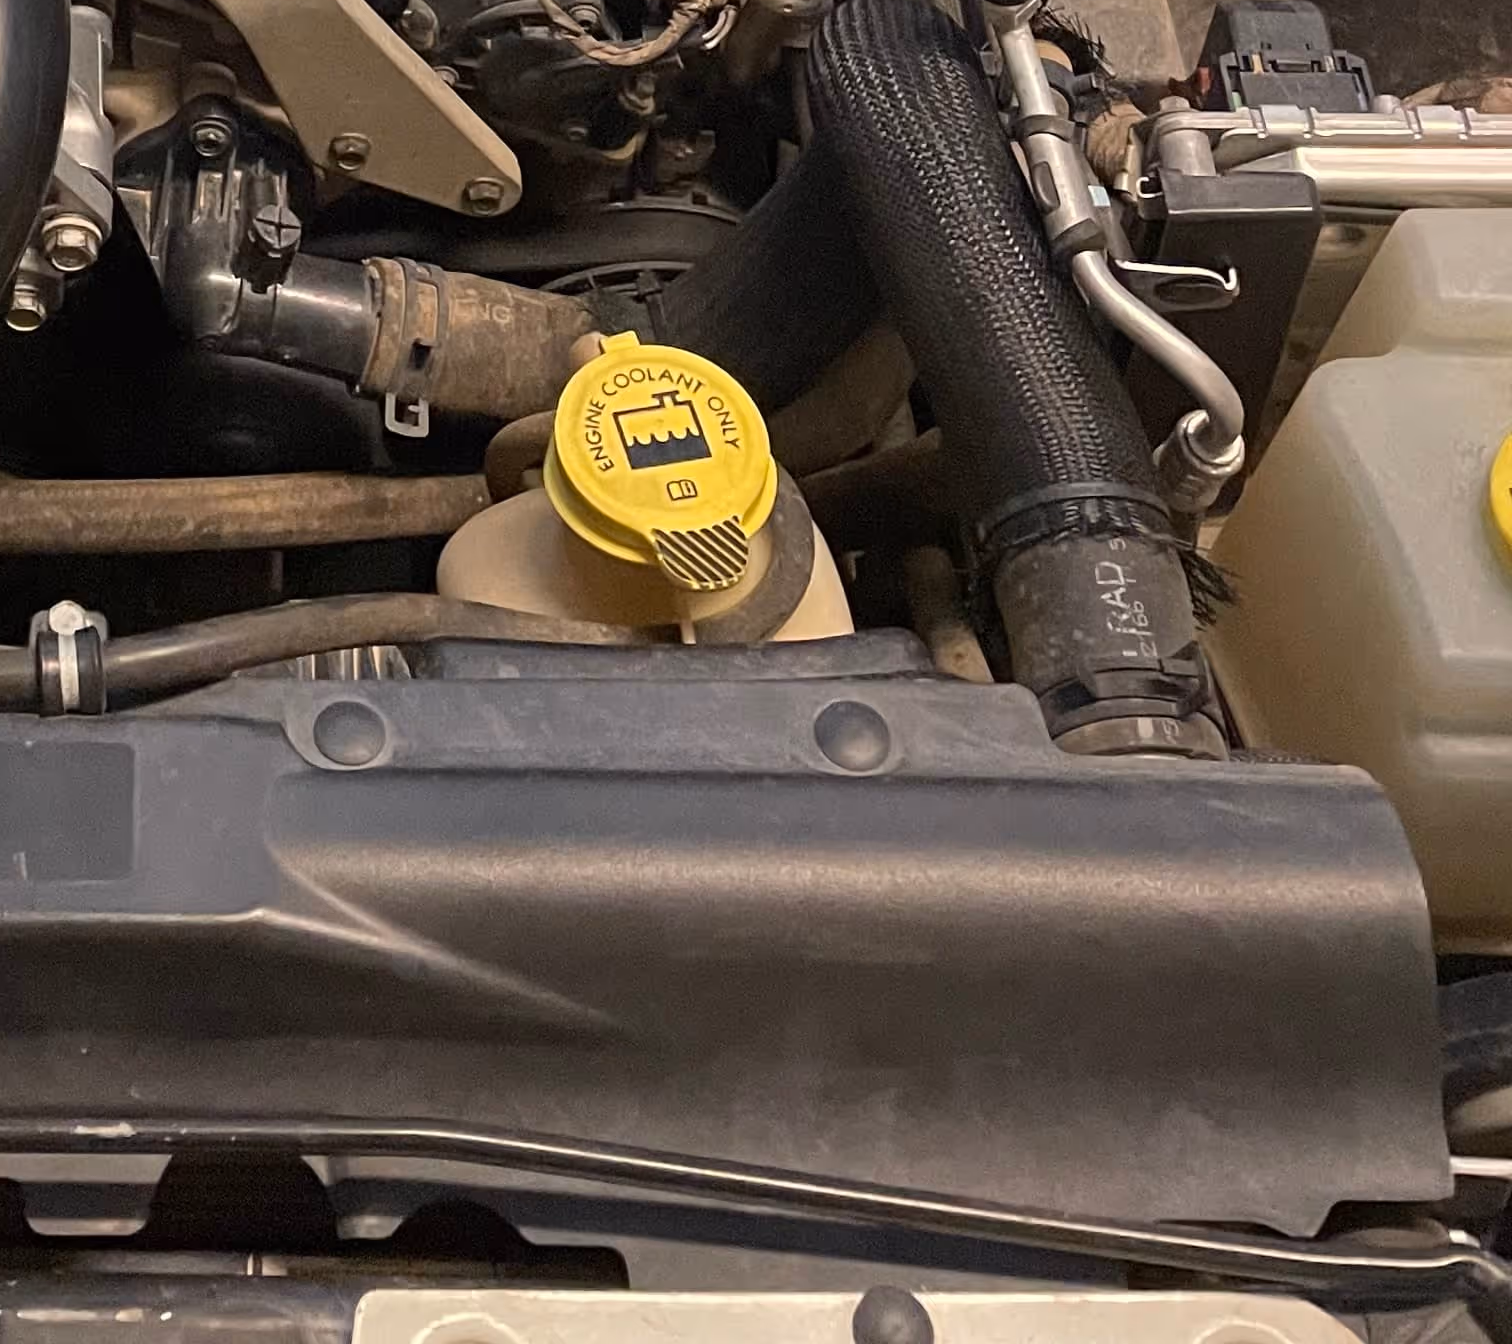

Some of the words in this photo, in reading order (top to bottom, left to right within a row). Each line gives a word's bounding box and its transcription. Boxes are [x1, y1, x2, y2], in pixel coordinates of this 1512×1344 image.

[584, 396, 615, 472] ENGINE
[601, 367, 706, 397] COOLANT
[706, 396, 740, 450] ONLY
